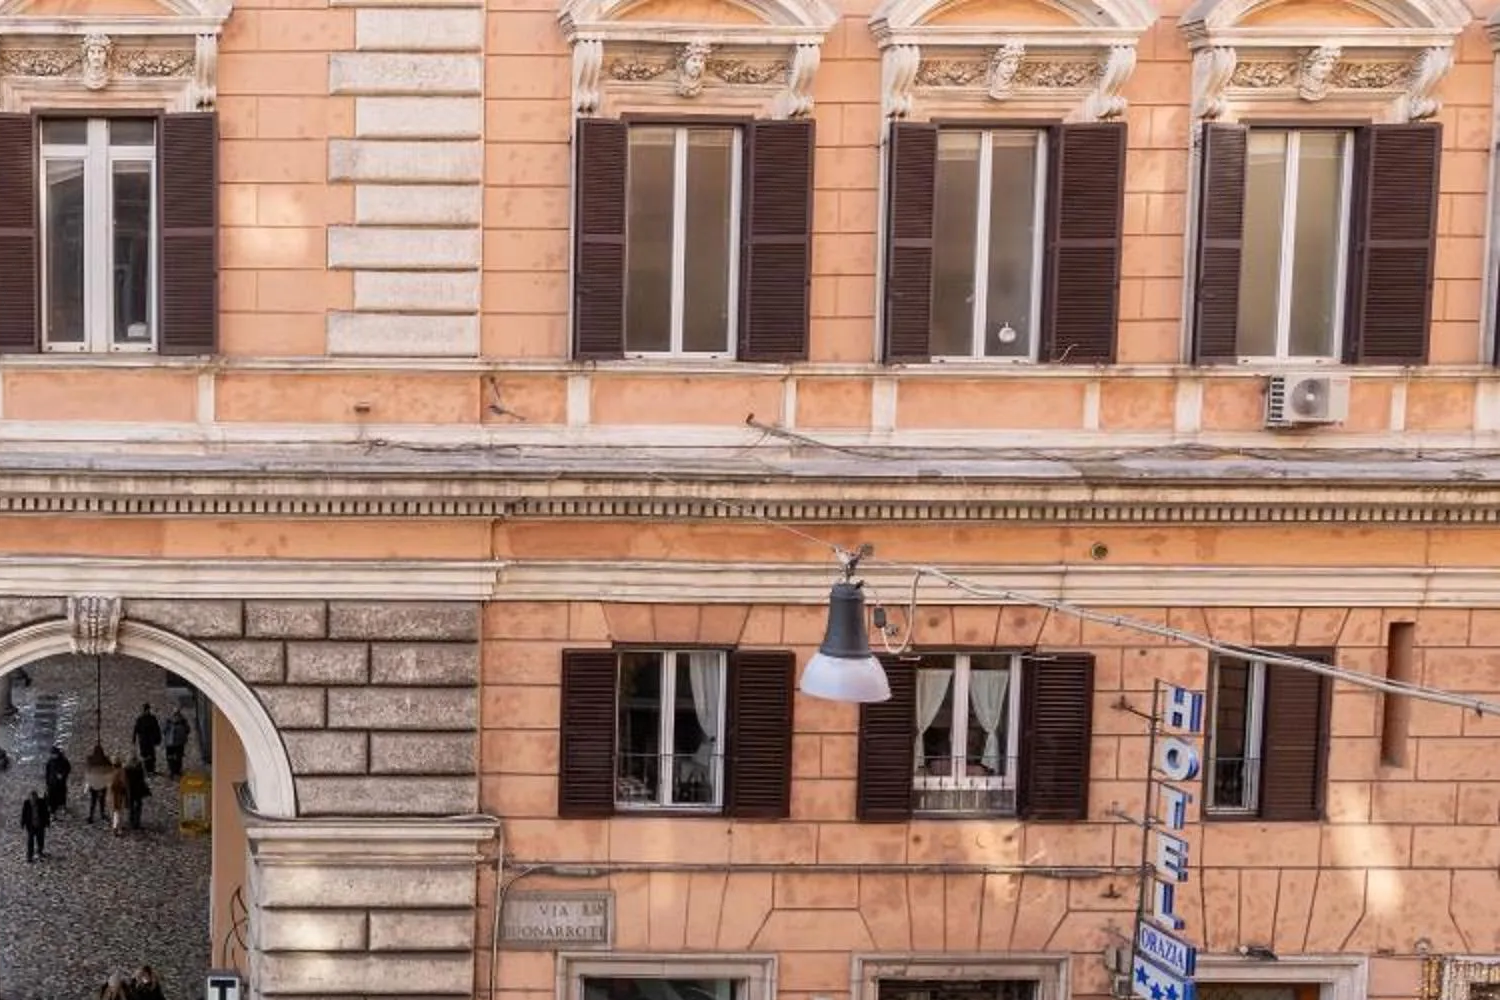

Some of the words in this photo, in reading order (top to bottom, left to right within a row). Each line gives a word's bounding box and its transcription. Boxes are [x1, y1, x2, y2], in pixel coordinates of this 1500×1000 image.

[1154, 682, 1204, 930] HOTEL
[539, 904, 569, 917] VIA
[1140, 926, 1186, 975] ORAZIA
